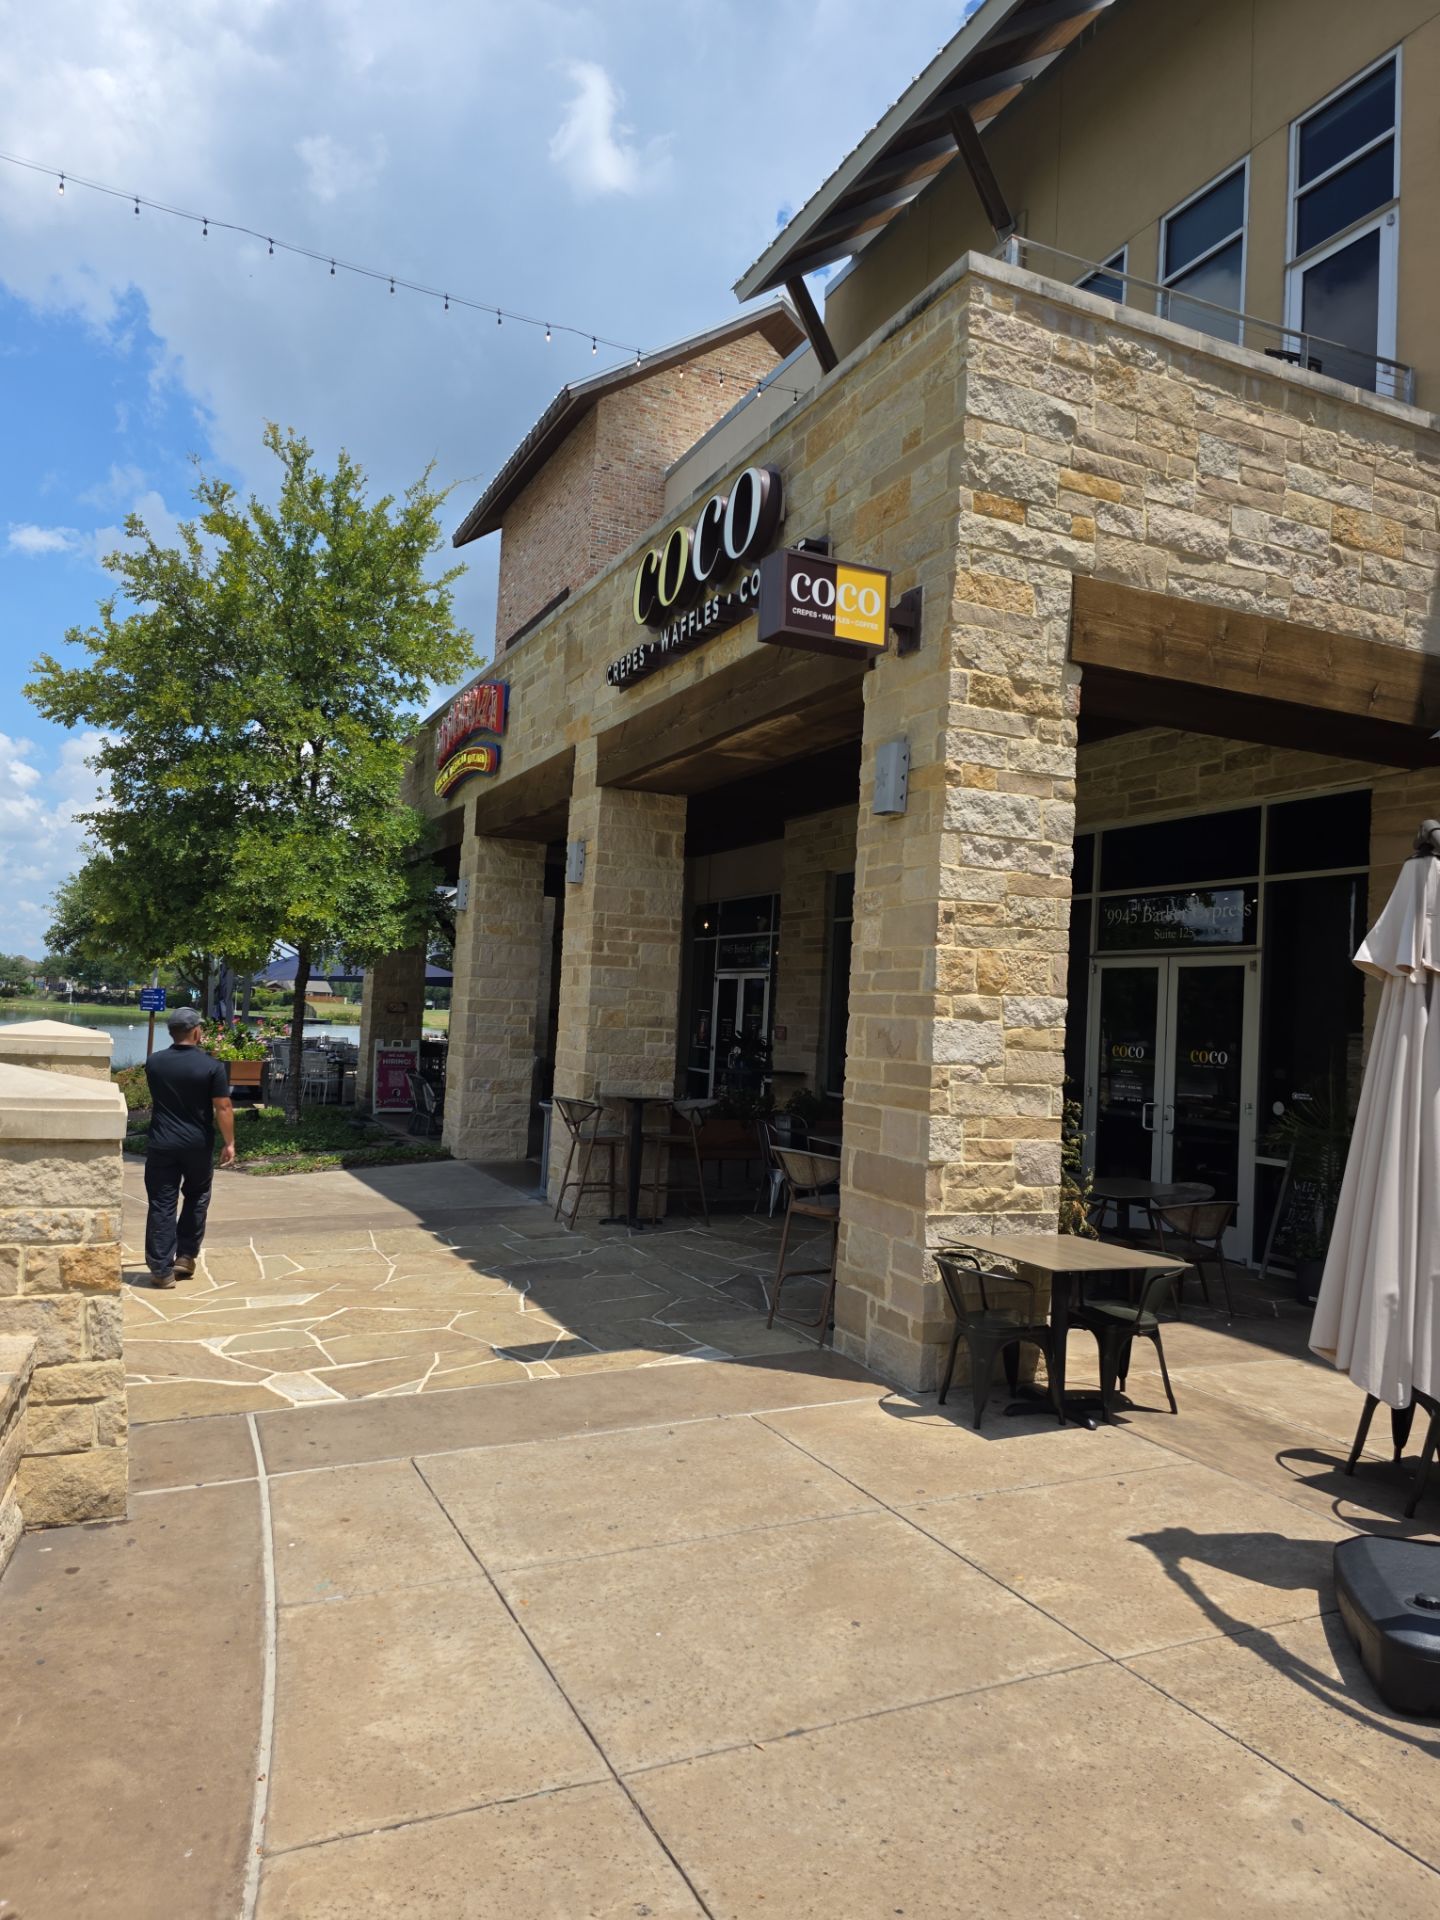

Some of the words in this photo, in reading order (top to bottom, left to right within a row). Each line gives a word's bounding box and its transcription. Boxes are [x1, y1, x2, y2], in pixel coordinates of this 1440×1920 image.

[633, 467, 764, 626] COCO
[790, 572, 881, 617] COCO
[792, 606, 818, 618] CREPES
[822, 612, 851, 625] WAFFLES
[606, 644, 645, 686] CREPES
[660, 594, 719, 652] WAFFLES
[739, 567, 761, 604] CO
[1107, 907, 1138, 926] 9945
[1192, 903, 1252, 924] press
[1154, 928, 1176, 940] Suite
[1112, 1044, 1145, 1059] COCO
[1190, 1049, 1228, 1065] COCO
